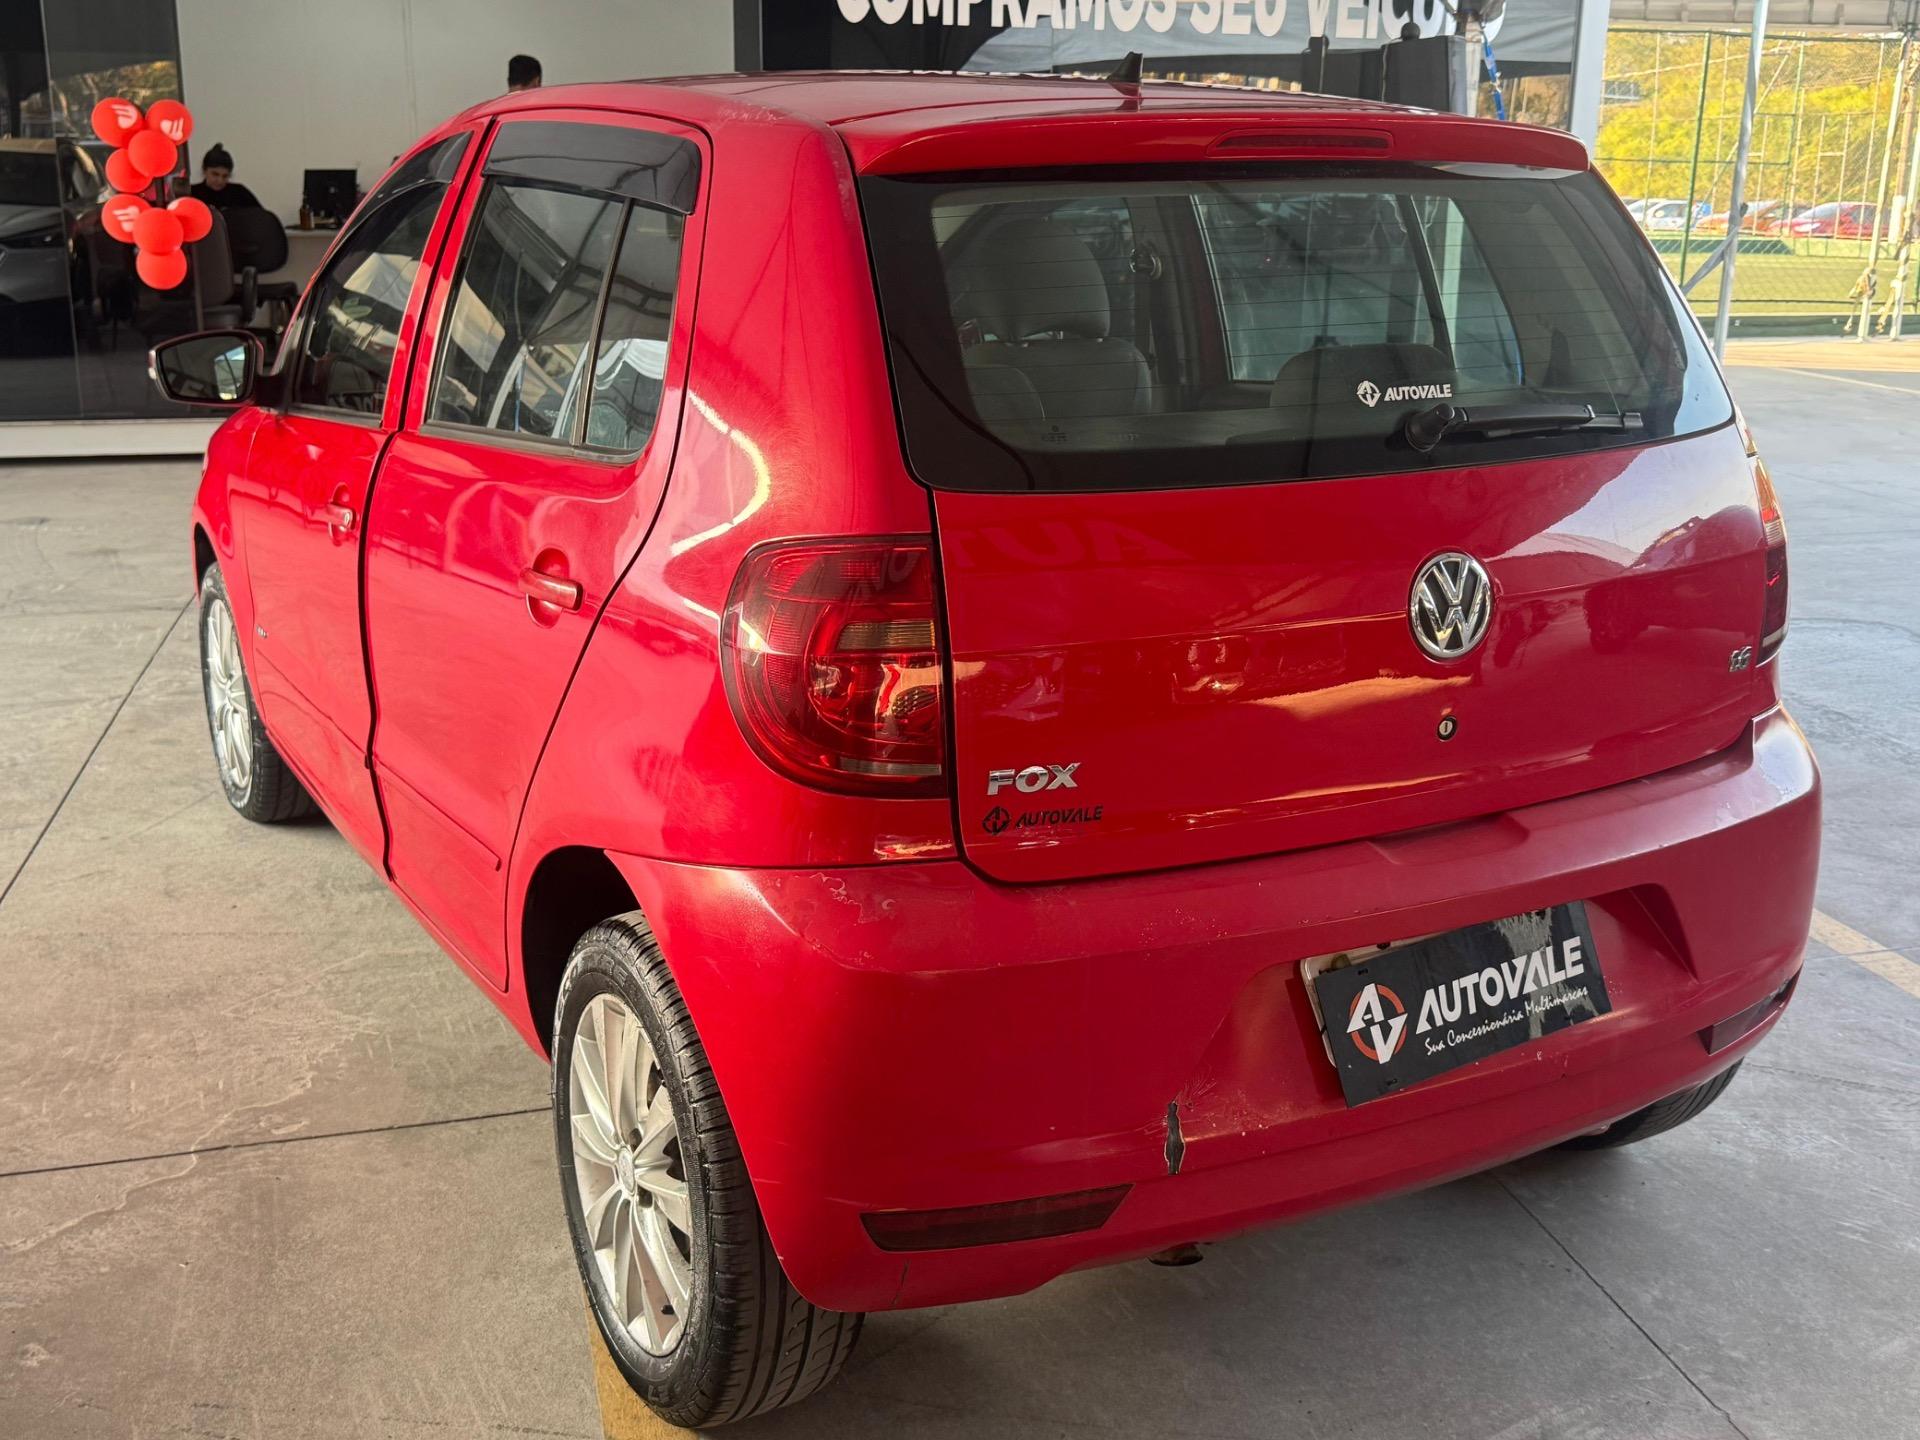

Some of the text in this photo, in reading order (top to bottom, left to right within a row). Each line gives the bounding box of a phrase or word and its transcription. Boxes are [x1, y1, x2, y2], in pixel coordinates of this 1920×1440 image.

[1384, 384, 1452, 402] AUTOVALE
[987, 762, 1082, 796] FOX
[1016, 805, 1103, 829] AUTOVALE
[1416, 936, 1585, 1035] AUTOVALE
[1424, 986, 1589, 1056] Sua Concessionária Multimarcas
